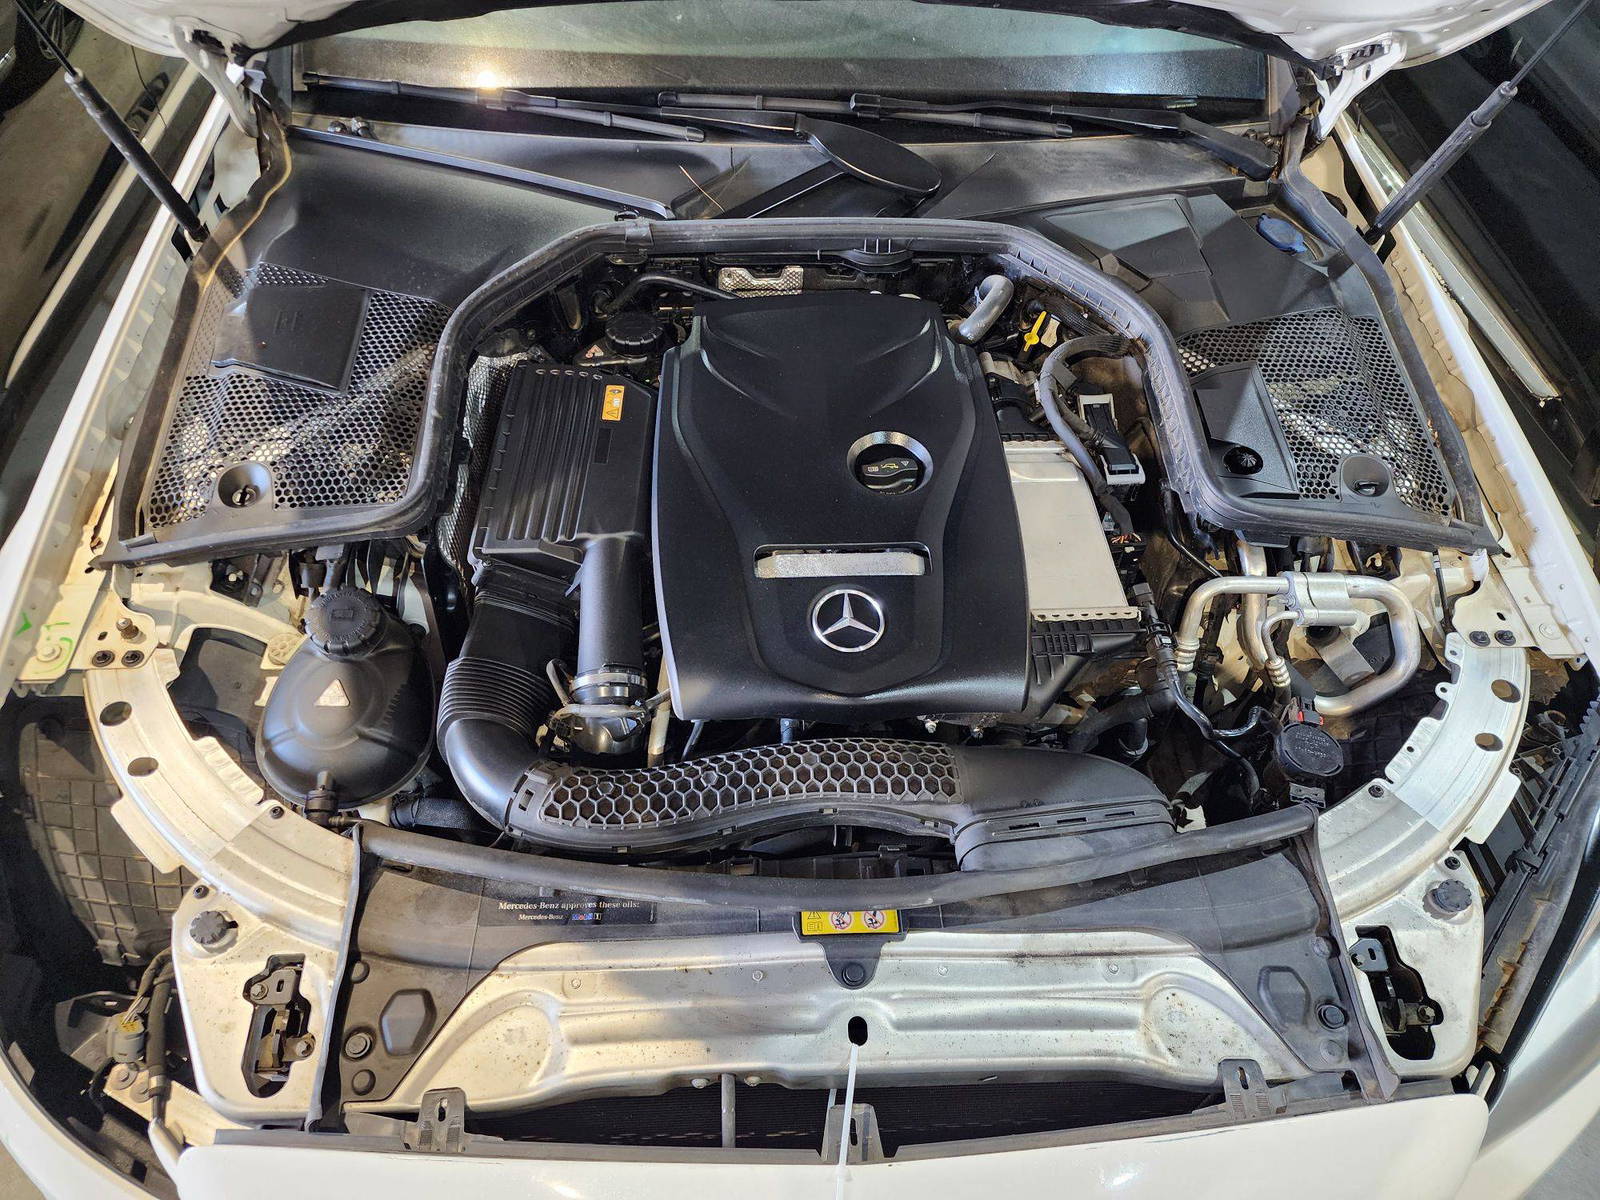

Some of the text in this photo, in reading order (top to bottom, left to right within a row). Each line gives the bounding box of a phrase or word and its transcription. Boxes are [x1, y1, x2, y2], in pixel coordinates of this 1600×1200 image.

[498, 901, 560, 910] Mercedes-Benz
[560, 901, 597, 910] approves
[599, 901, 621, 909] these
